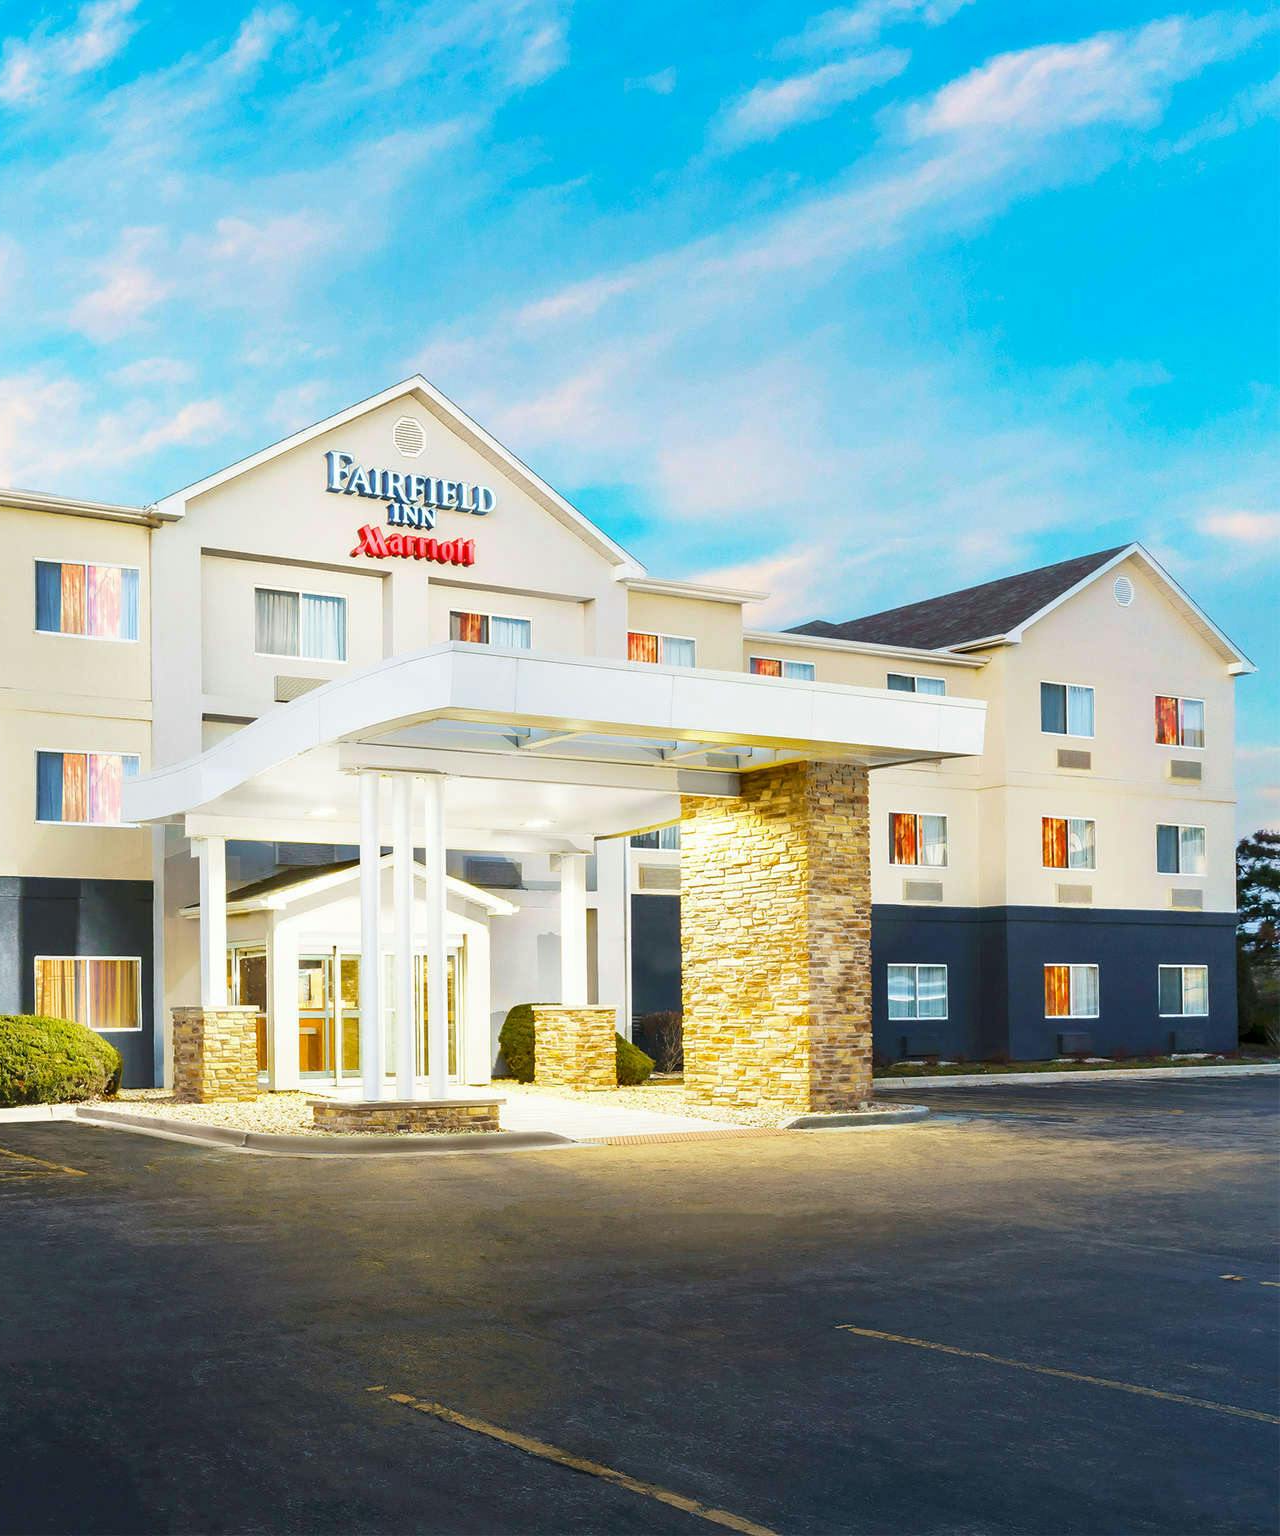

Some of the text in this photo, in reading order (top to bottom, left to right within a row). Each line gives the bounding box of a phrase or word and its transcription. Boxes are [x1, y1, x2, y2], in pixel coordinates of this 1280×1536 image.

[325, 451, 496, 515] FAIRFIELD
[387, 502, 437, 530] INN
[350, 524, 476, 567] Marriott
